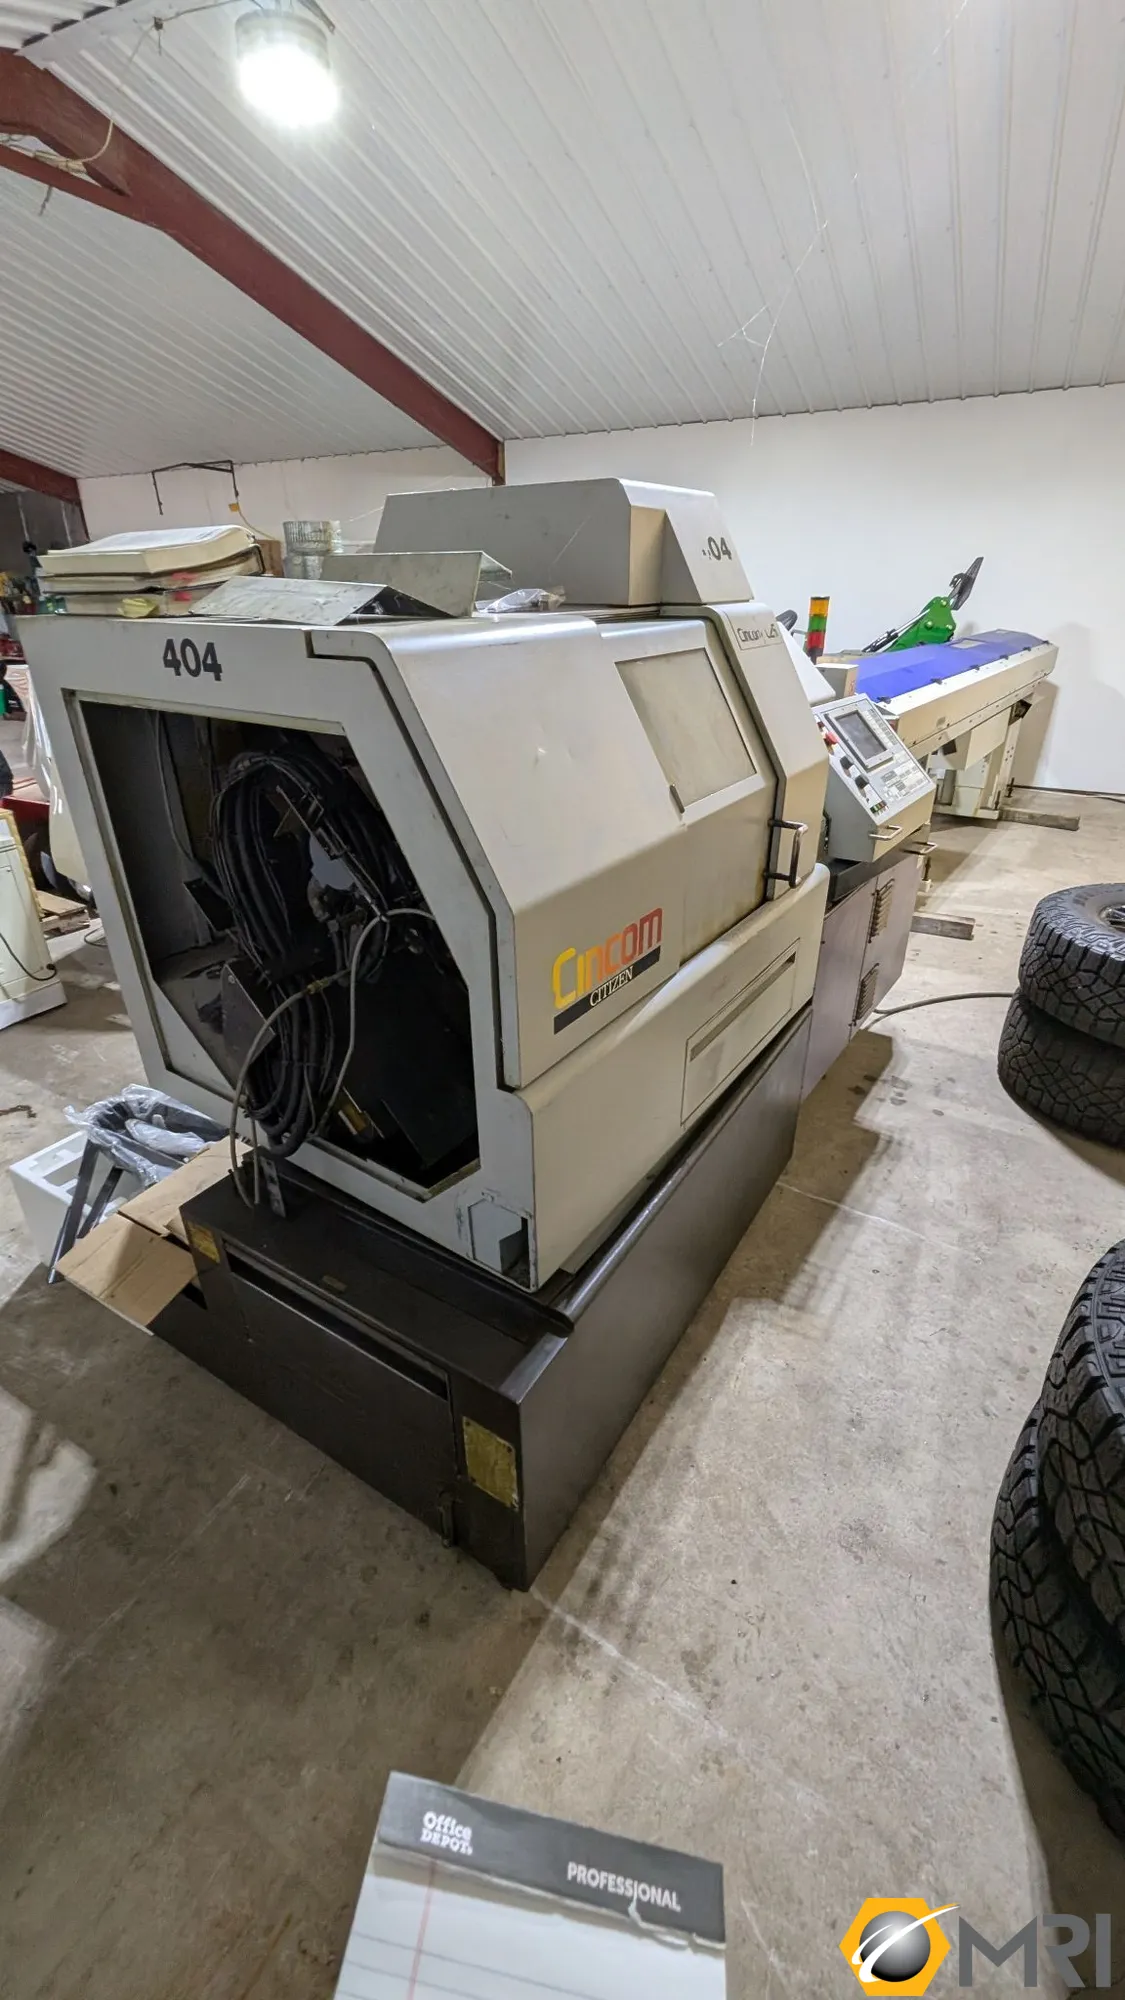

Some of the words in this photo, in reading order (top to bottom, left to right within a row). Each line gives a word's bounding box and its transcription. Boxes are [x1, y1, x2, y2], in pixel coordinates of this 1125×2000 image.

[702, 536, 732, 561] 04
[162, 637, 223, 682] 404
[552, 907, 663, 1009] Cincom
[589, 965, 635, 1007] CITIZEN
[423, 1810, 473, 1841] Office
[567, 1861, 682, 1913] PROFESSIONAL
